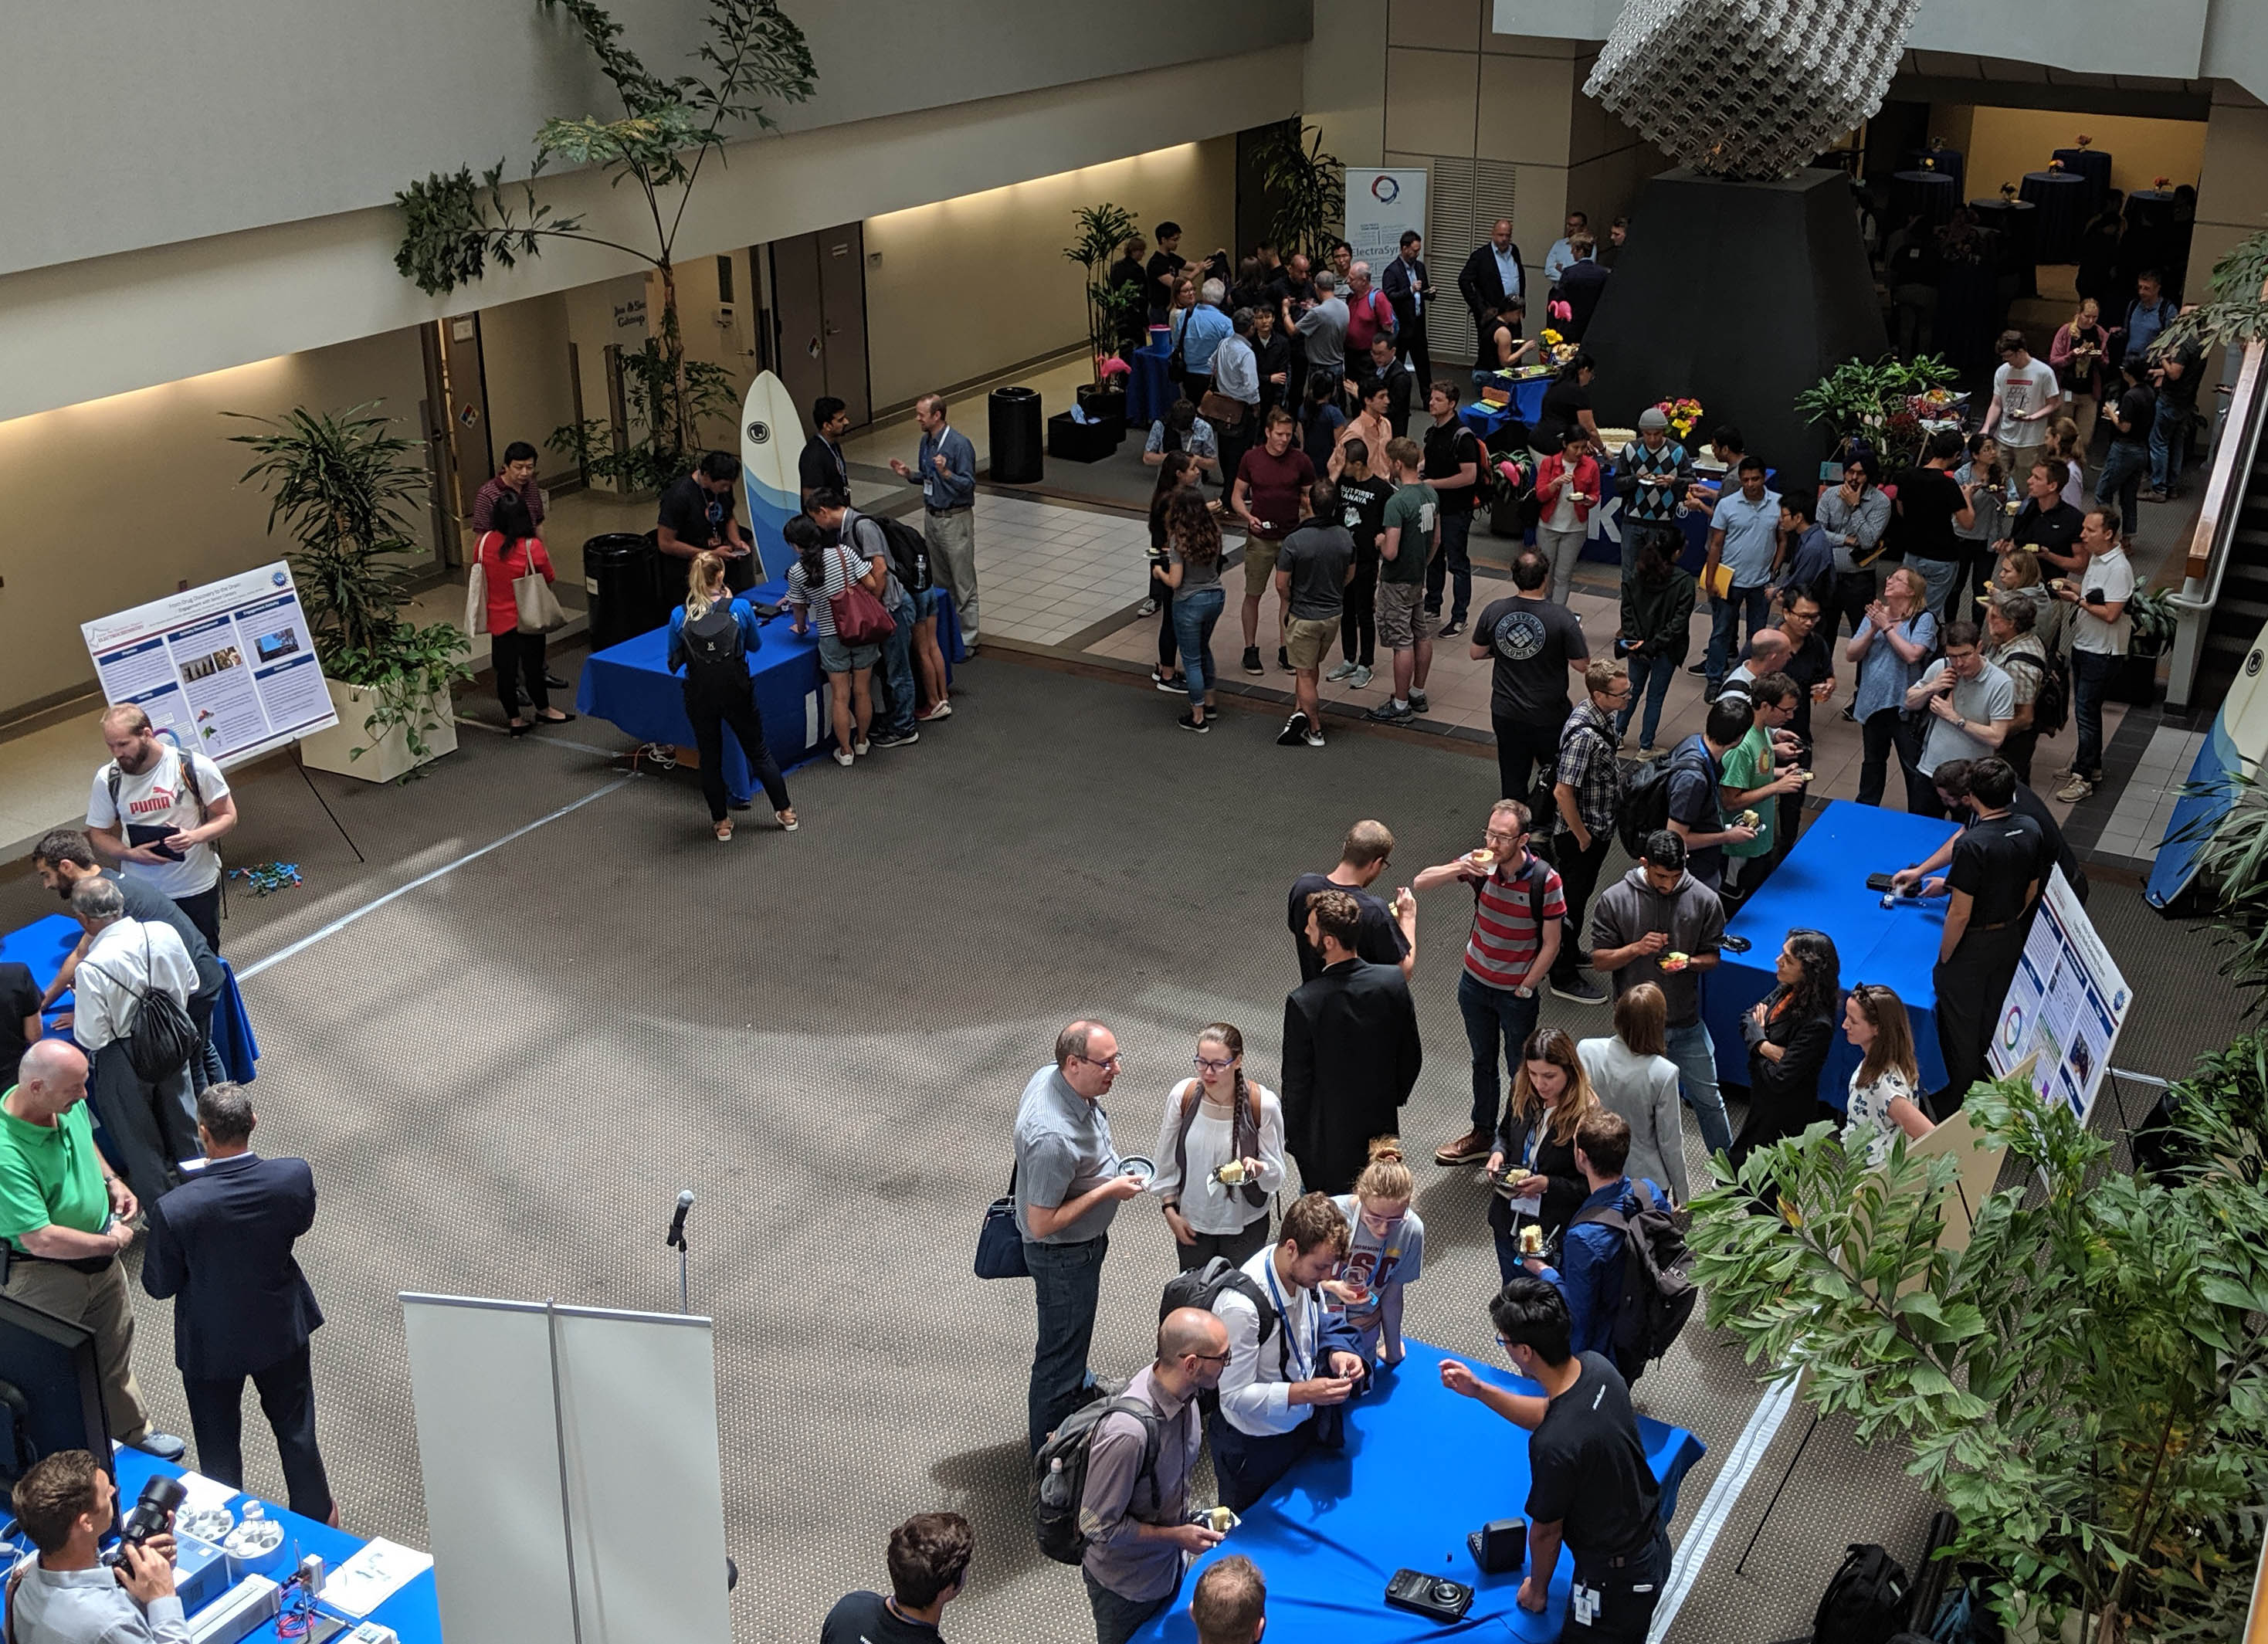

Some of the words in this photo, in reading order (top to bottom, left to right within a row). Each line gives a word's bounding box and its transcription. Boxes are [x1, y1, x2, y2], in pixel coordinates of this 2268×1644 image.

[1341, 485, 1354, 494] BUT
[1354, 489, 1375, 500] FIRST.
[130, 796, 171, 815] PUMA
